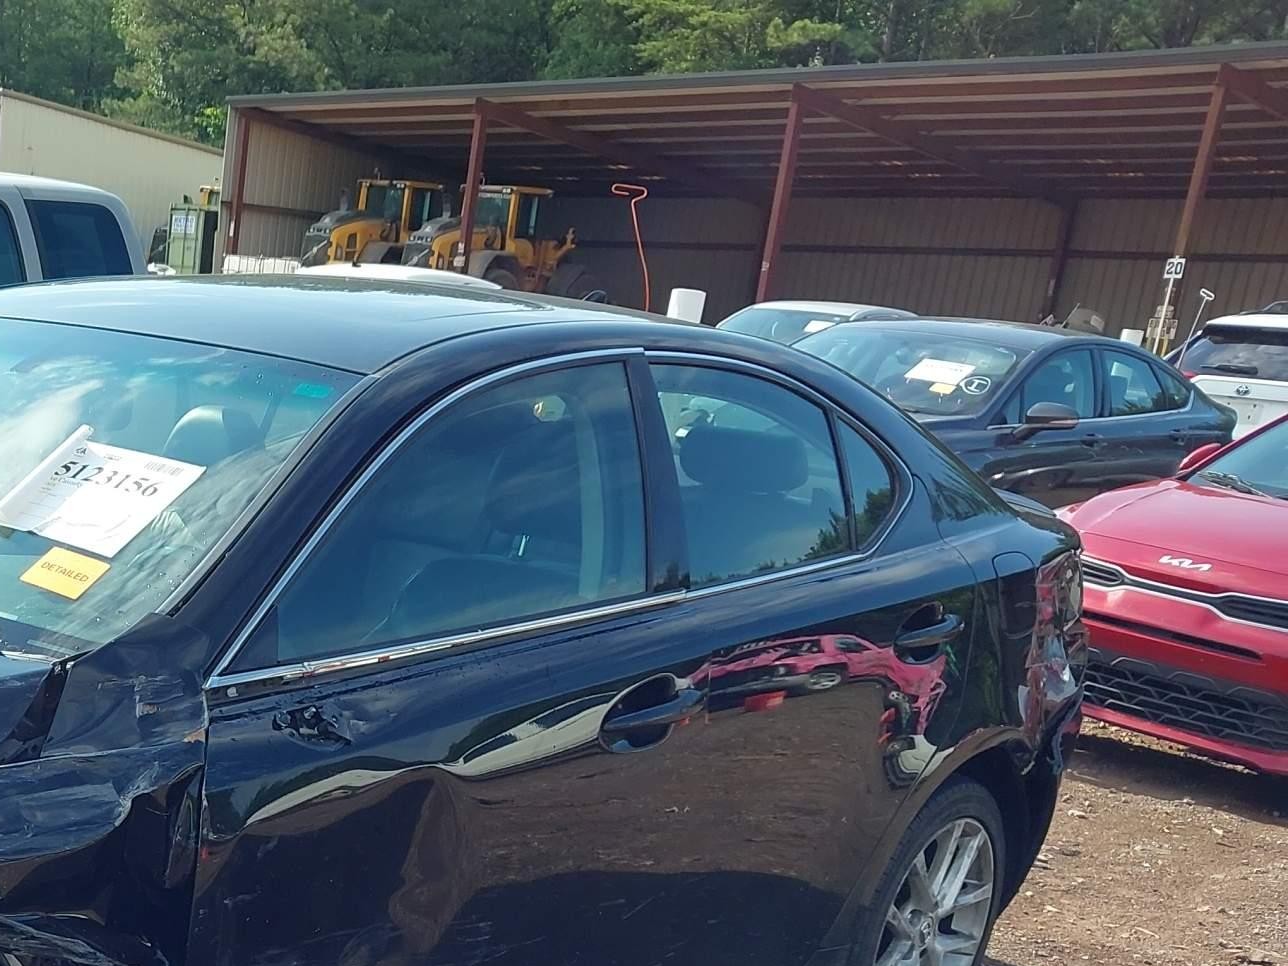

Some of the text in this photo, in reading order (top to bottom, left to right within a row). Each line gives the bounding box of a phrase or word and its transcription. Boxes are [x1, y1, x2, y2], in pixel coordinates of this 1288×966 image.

[1165, 261, 1183, 275] 20
[54, 460, 164, 498] 5123156
[40, 560, 90, 584] DETAILED
